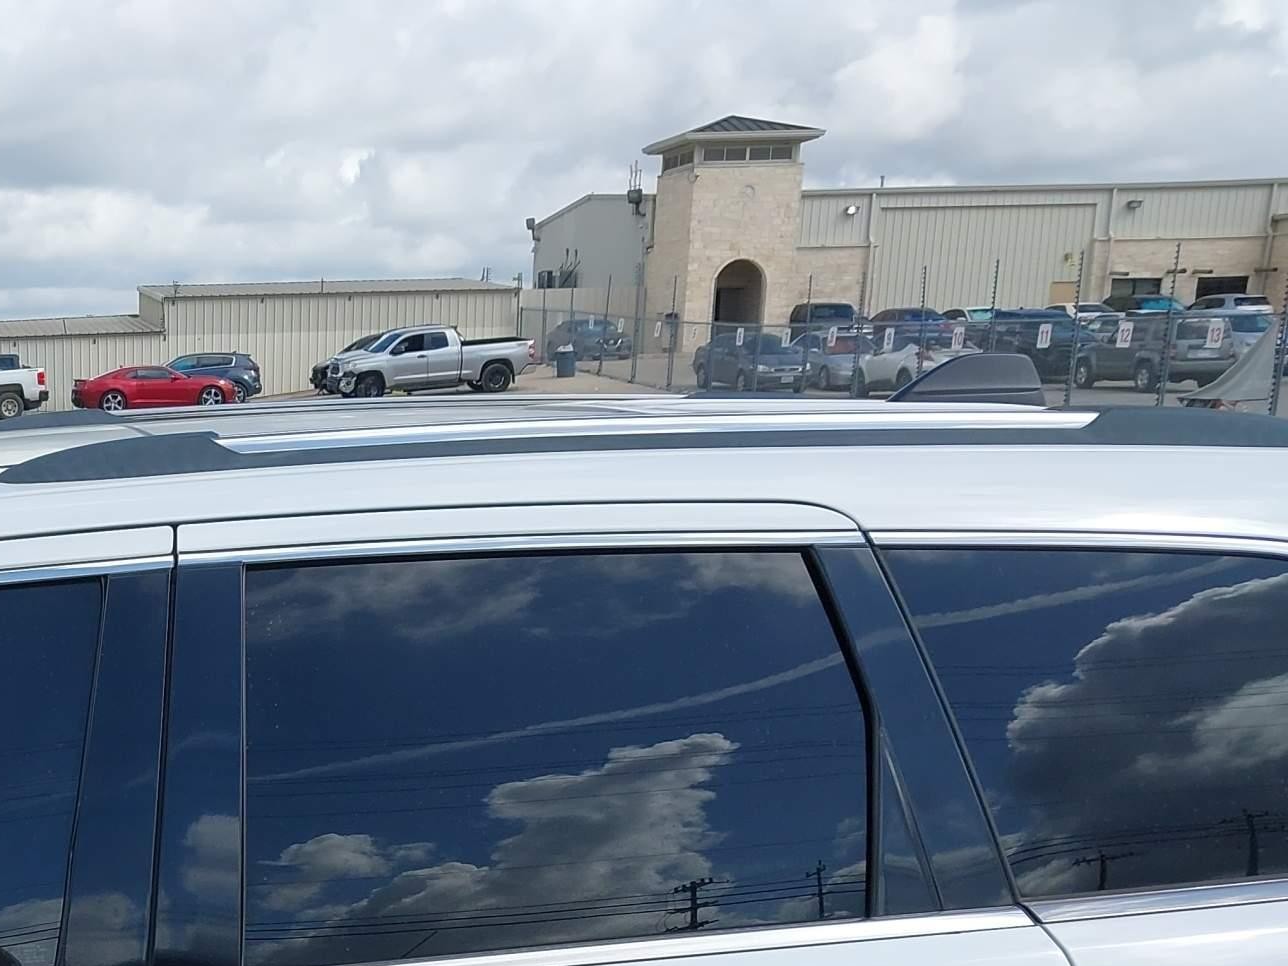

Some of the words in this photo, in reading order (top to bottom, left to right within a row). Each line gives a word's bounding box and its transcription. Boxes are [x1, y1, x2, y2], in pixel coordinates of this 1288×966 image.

[953, 331, 963, 346] 10
[1040, 329, 1049, 345] 11
[1119, 328, 1132, 344] 12
[1209, 327, 1222, 344] 13
